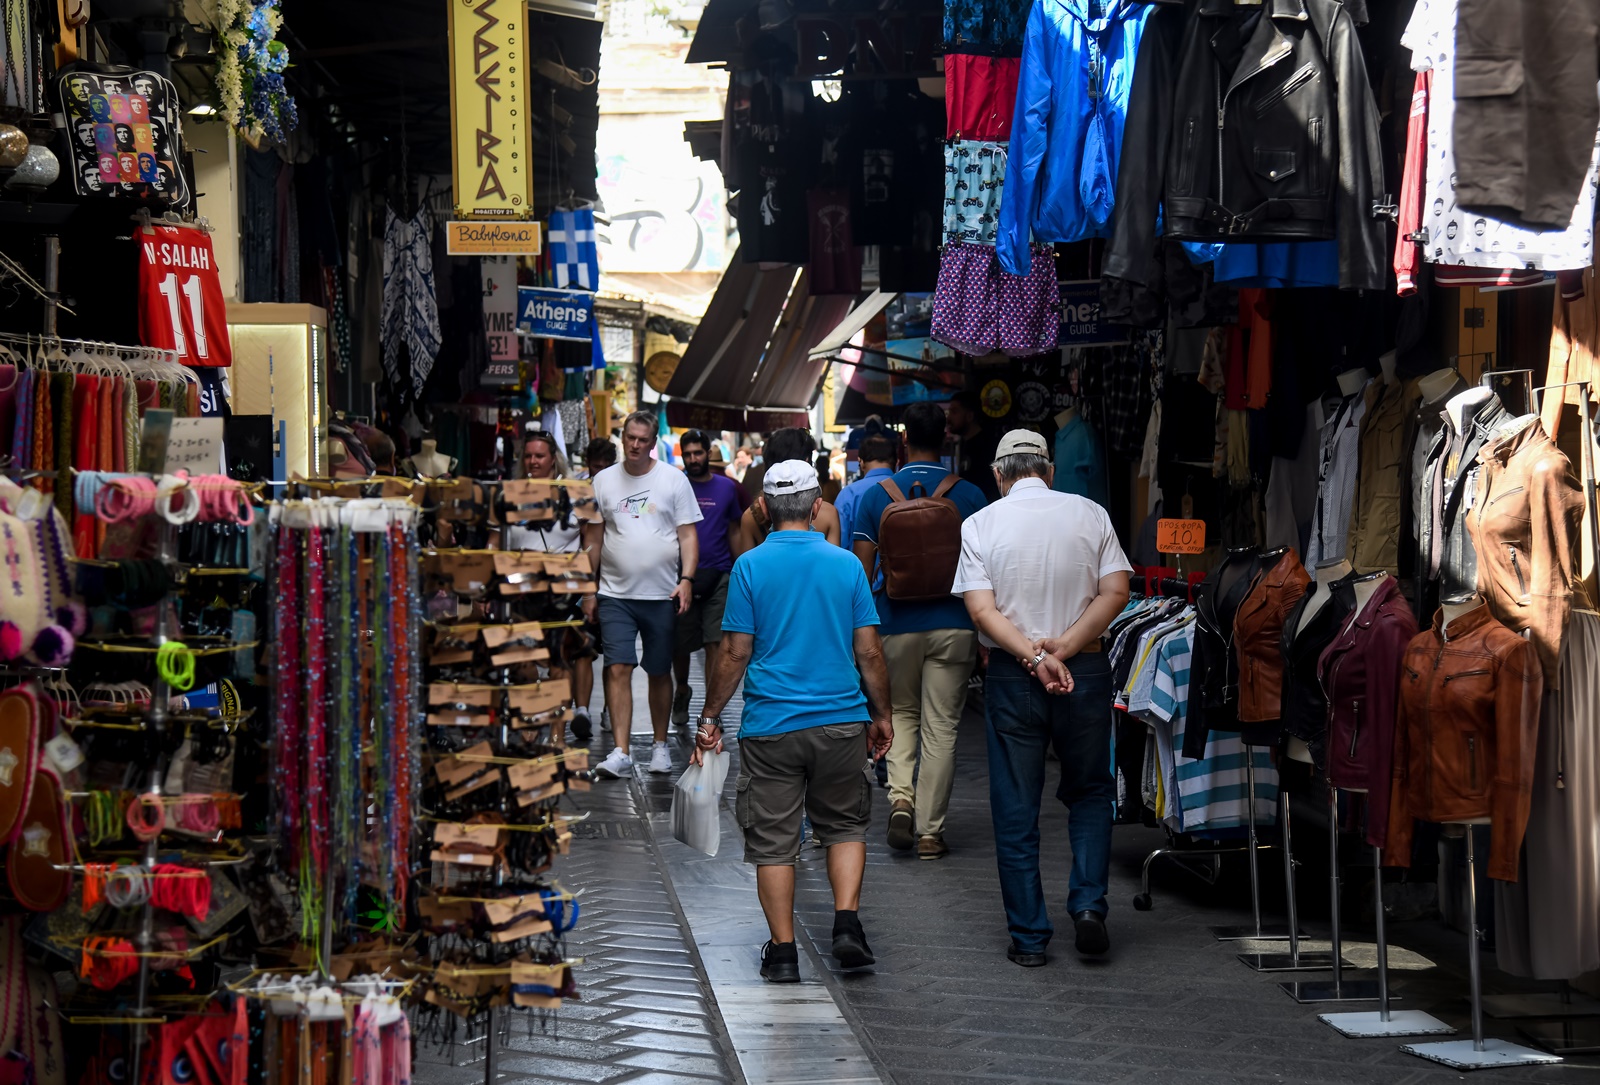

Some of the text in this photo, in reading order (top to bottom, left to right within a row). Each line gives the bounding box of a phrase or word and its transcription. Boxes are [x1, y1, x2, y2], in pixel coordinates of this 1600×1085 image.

[507, 23, 519, 173] accessories
[455, 224, 531, 247] Babylonia
[158, 272, 209, 359] 11
[523, 299, 588, 323] Athens
[545, 320, 569, 331] GUIDE
[1069, 323, 1098, 336] GUIDE
[485, 364, 515, 375] FERS
[201, 383, 218, 413] si
[221, 684, 236, 716] RIGINAL
